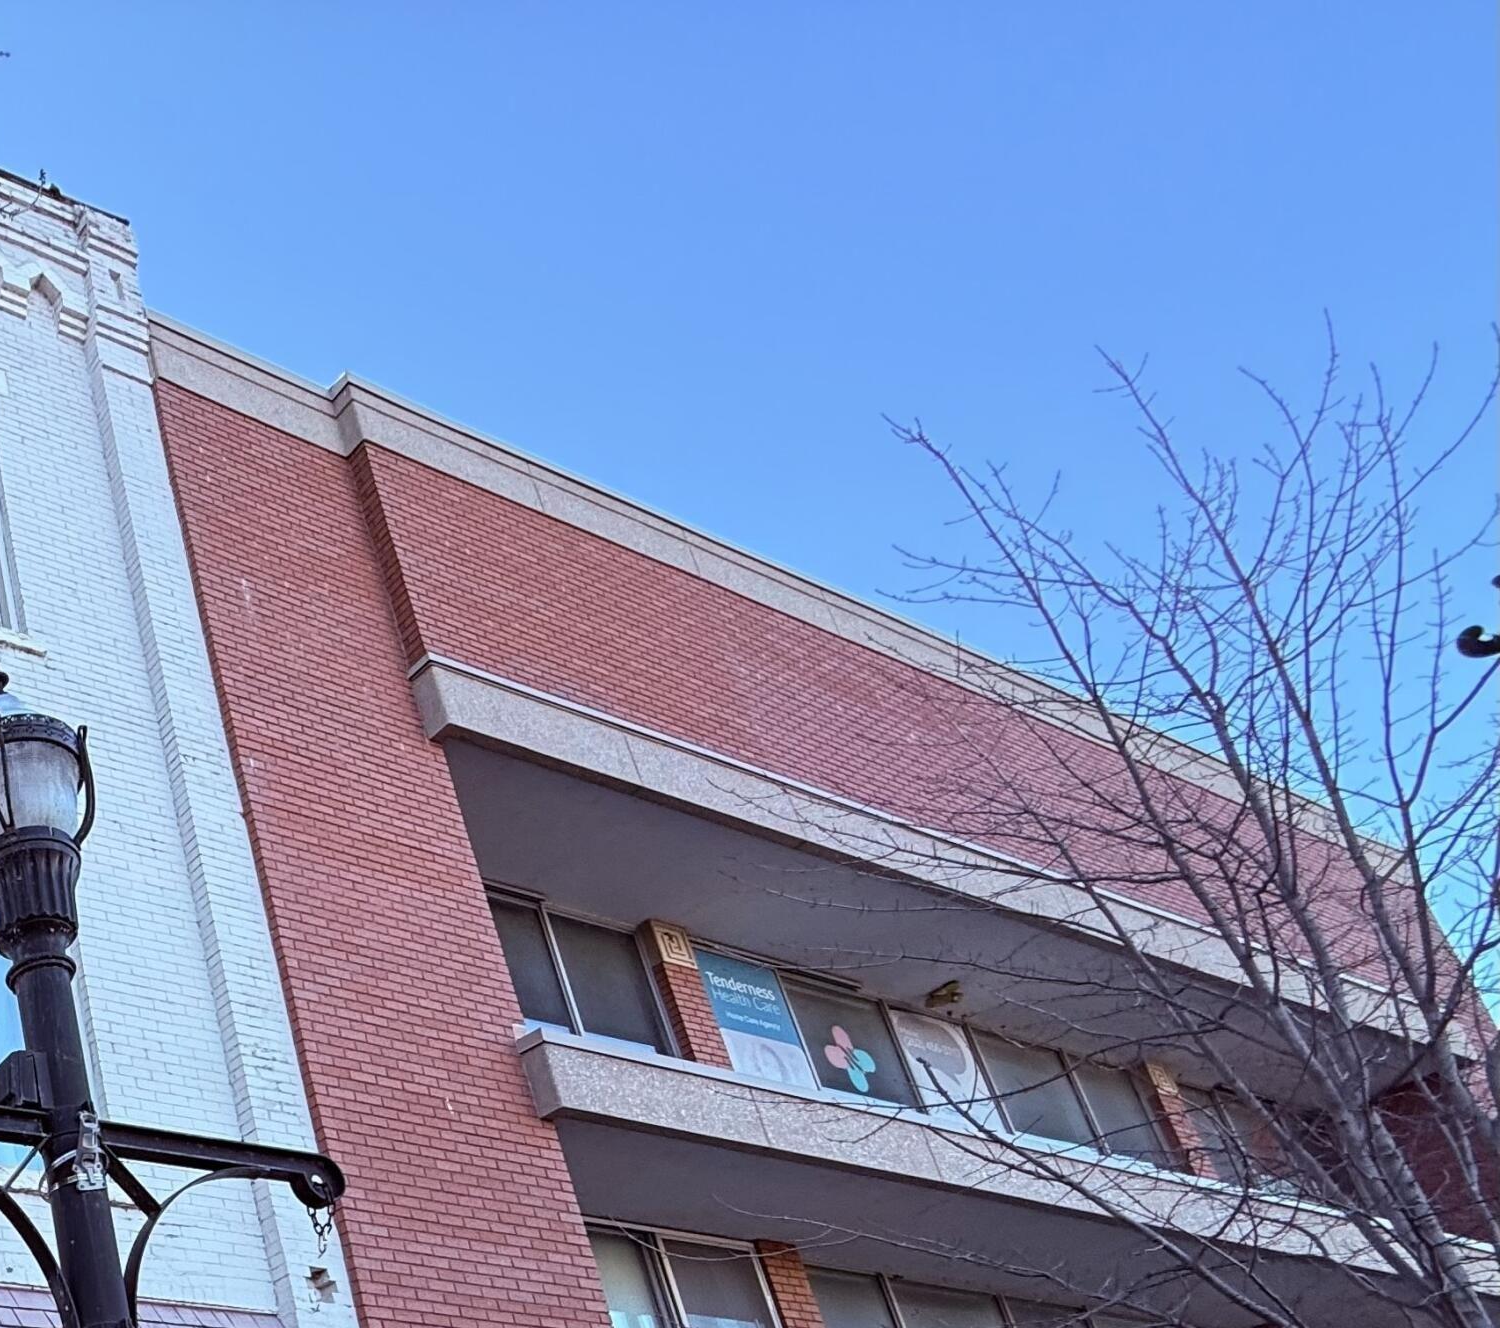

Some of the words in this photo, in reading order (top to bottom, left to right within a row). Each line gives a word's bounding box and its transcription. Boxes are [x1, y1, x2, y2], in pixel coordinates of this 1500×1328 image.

[705, 971, 776, 1001] Tenderness
[711, 987, 752, 1008] Health
[753, 997, 781, 1016] Care
